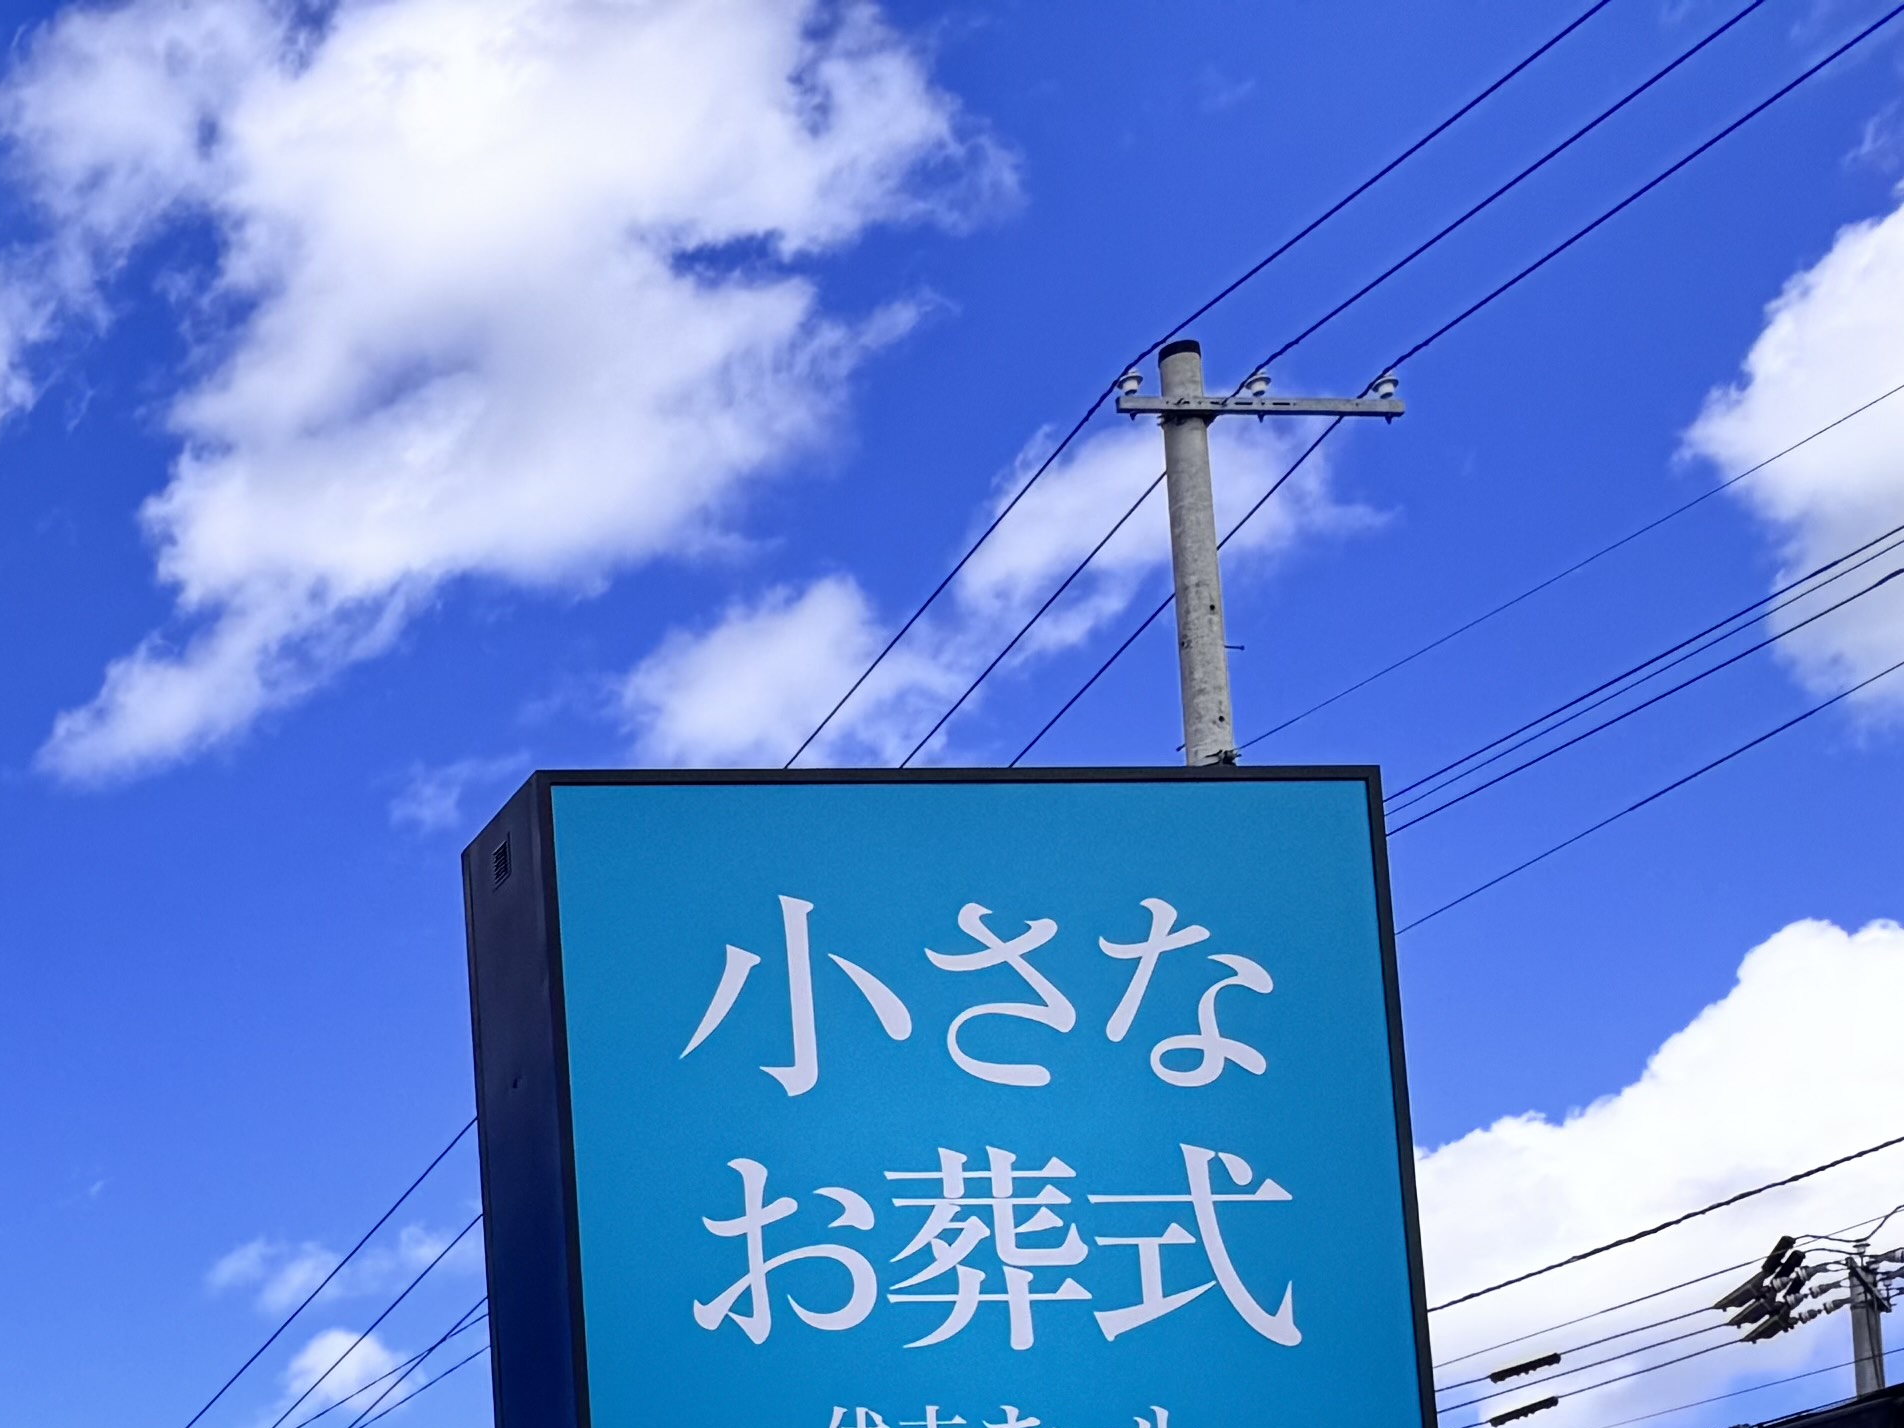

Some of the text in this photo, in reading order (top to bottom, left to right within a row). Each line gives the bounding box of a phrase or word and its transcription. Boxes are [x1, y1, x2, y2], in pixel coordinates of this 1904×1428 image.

[679, 894, 1275, 1097] 小さな
[692, 1142, 1304, 1351] お葬式
